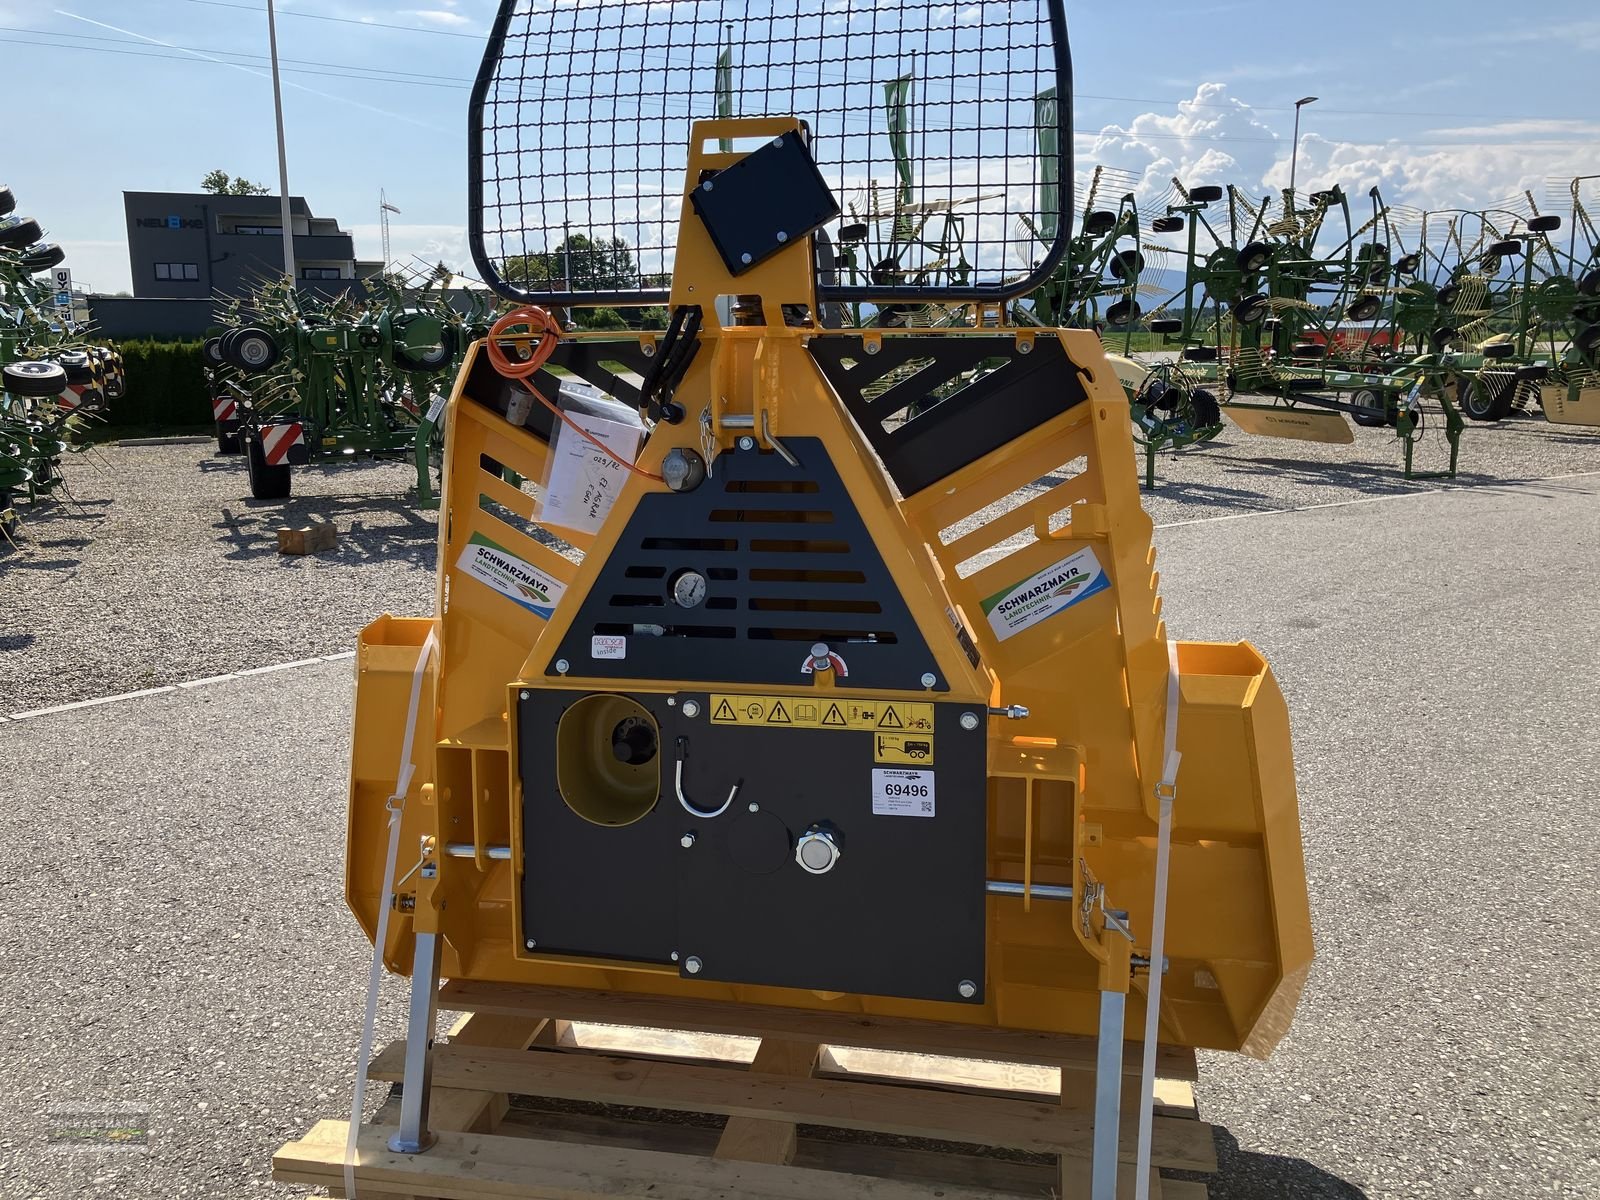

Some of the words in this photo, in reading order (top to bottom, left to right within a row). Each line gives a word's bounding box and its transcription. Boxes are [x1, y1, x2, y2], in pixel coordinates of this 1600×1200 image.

[474, 557, 516, 585] LANDTECHNIK
[477, 547, 549, 594] SCHWARZMAYR
[997, 567, 1080, 614] SCHWARZMAYR
[1004, 593, 1052, 621] LANDTECHNIK
[885, 783, 928, 797] 69496
